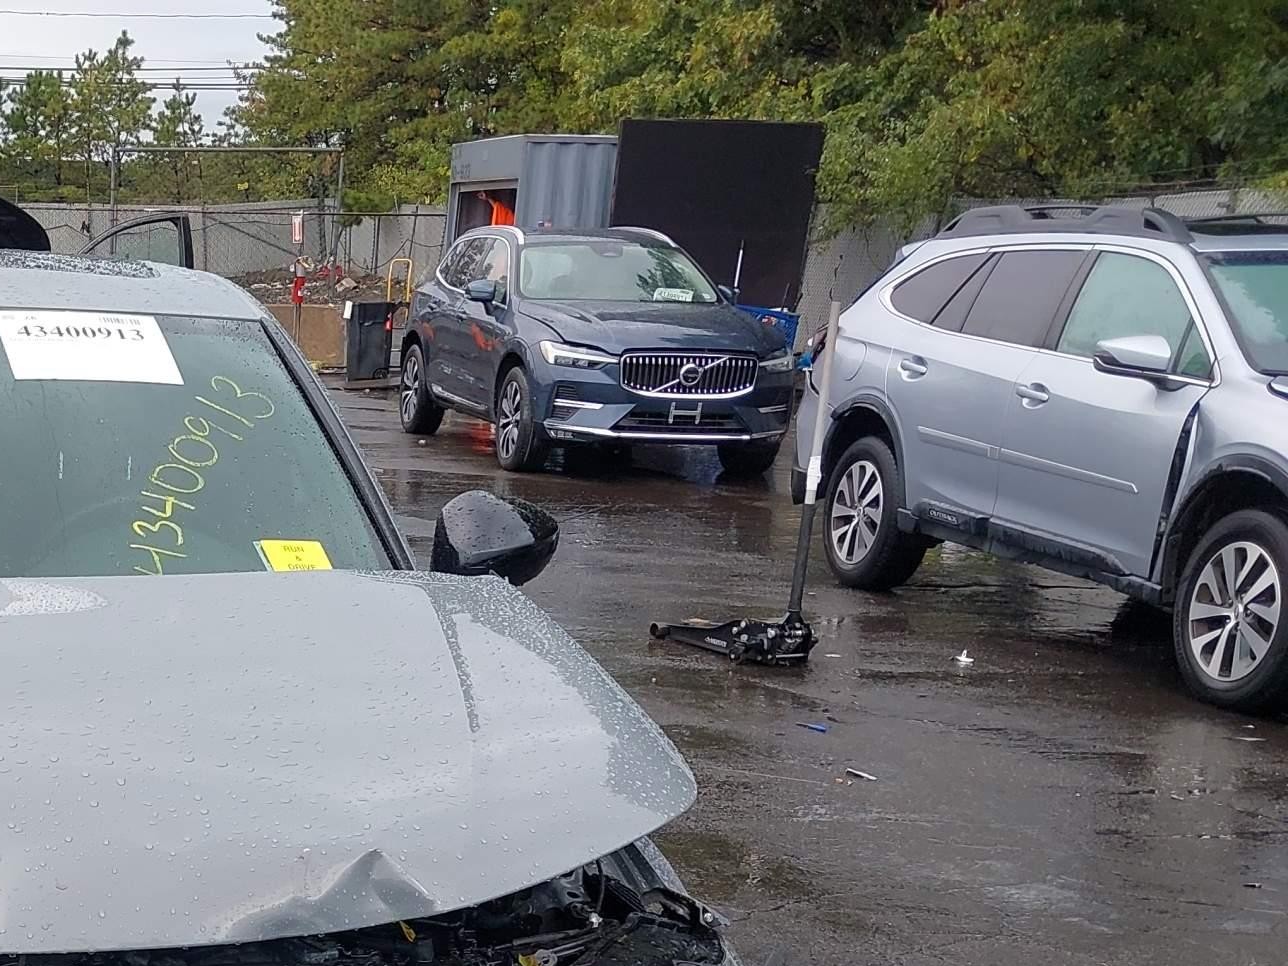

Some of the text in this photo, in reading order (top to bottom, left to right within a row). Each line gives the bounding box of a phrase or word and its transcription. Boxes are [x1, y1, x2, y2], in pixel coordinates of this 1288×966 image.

[17, 325, 145, 341] 43400913
[130, 375, 275, 575] 43400913
[282, 545, 305, 553] RUN
